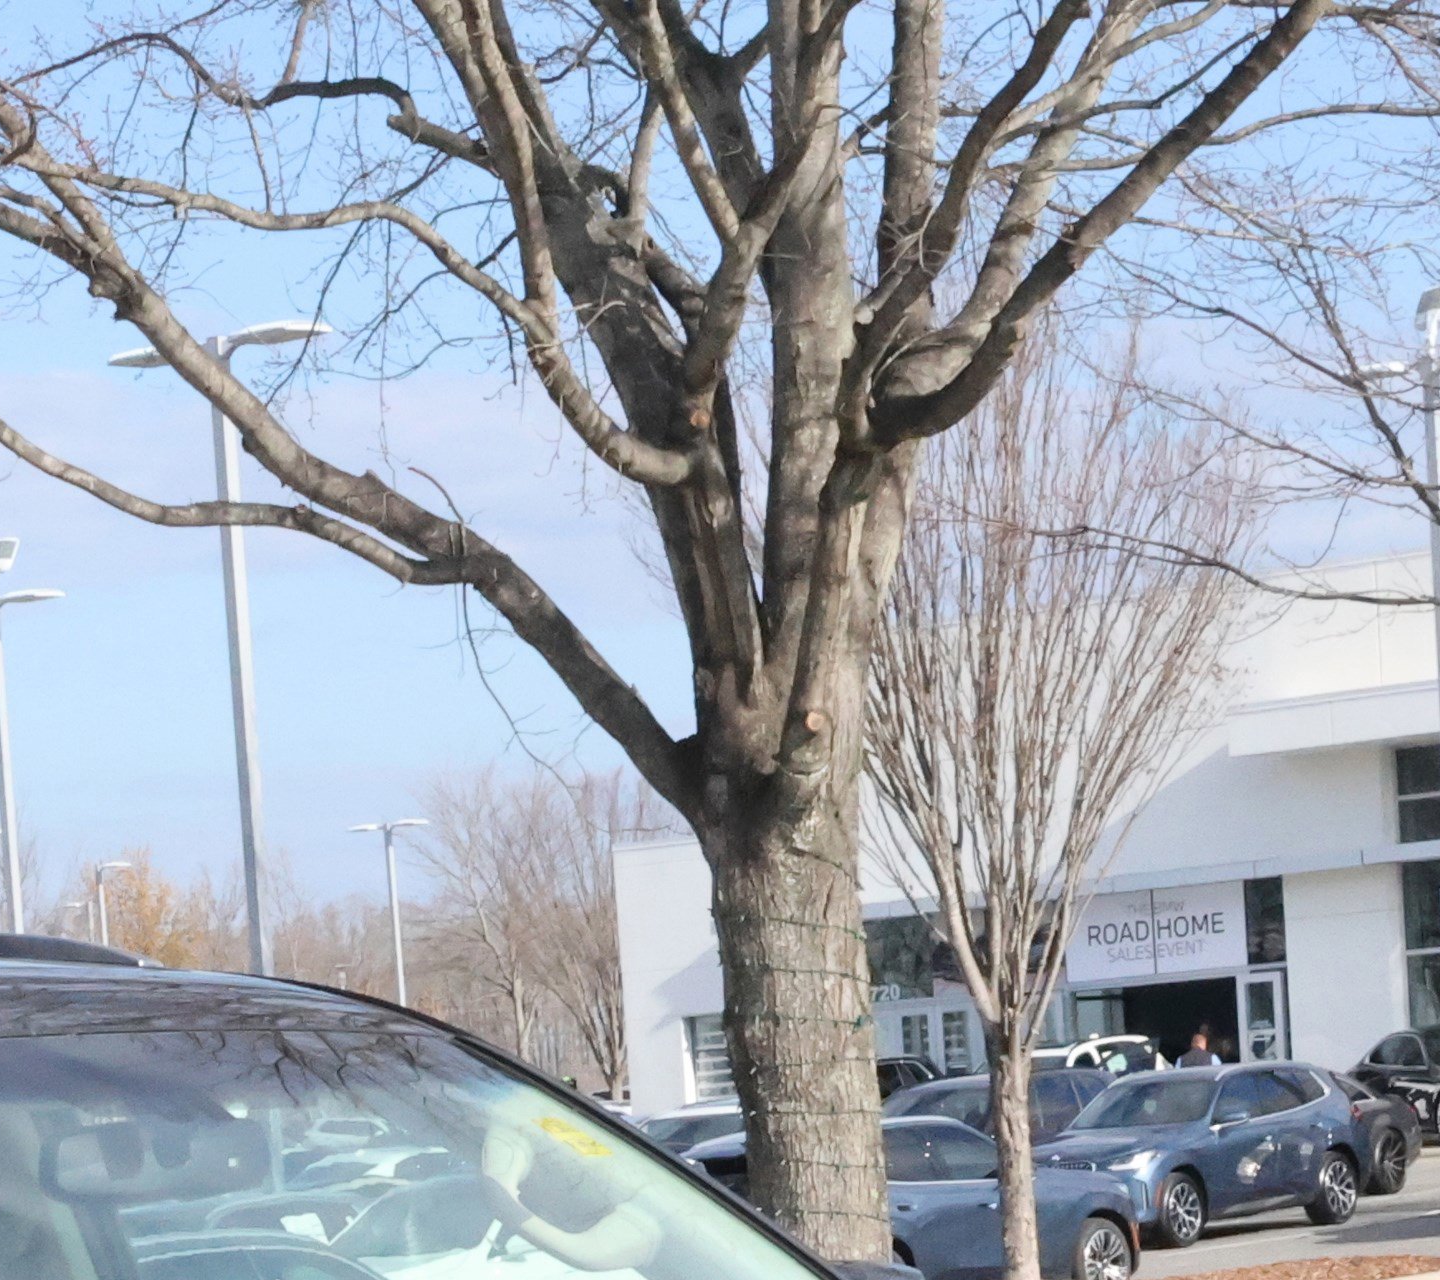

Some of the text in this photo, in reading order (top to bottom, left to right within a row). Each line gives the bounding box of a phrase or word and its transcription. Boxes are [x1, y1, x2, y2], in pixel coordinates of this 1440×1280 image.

[1087, 911, 1225, 947] ROAD HOME
[1106, 939, 1204, 963] SALES EVENT
